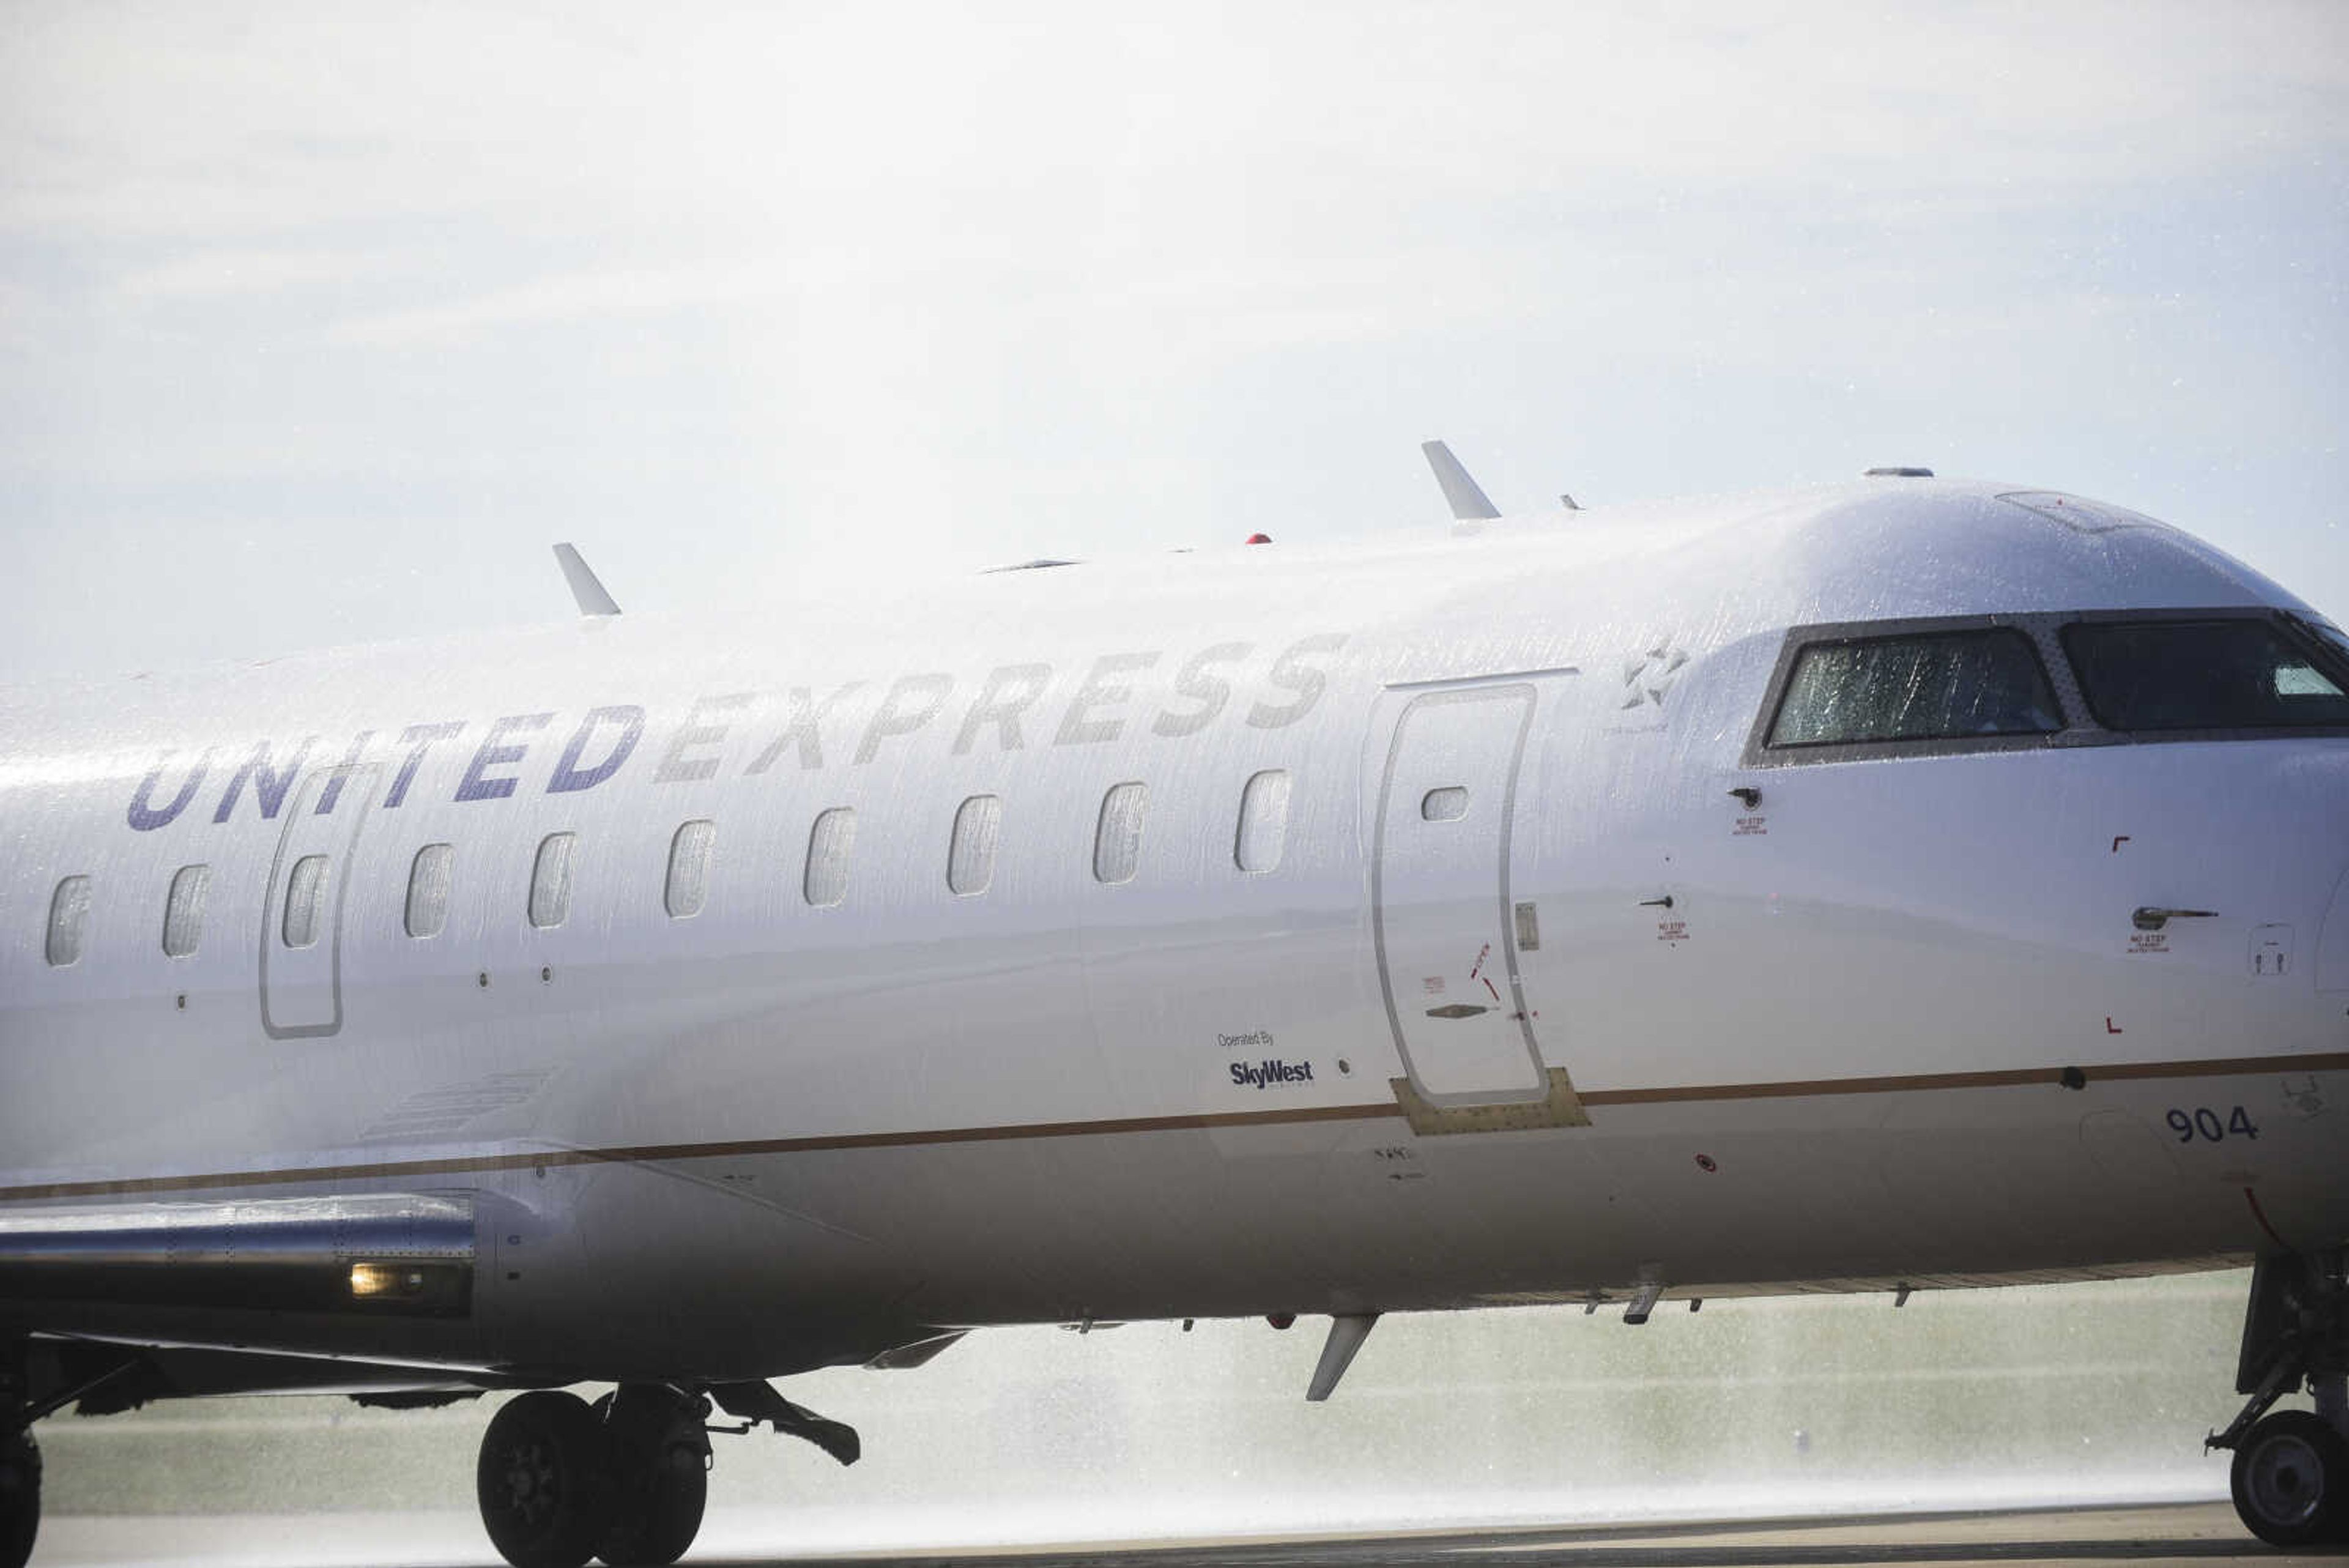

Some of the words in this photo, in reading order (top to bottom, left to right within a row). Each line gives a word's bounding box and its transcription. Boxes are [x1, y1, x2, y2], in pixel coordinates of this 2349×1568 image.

[127, 705, 645, 831] UNITED
[652, 634, 1351, 784] EXPRESS
[1218, 1031, 1259, 1049] Operated
[1260, 1030, 1274, 1046] By
[1230, 1060, 1314, 1090] SkyWest
[2165, 1105, 2258, 1143] 904
